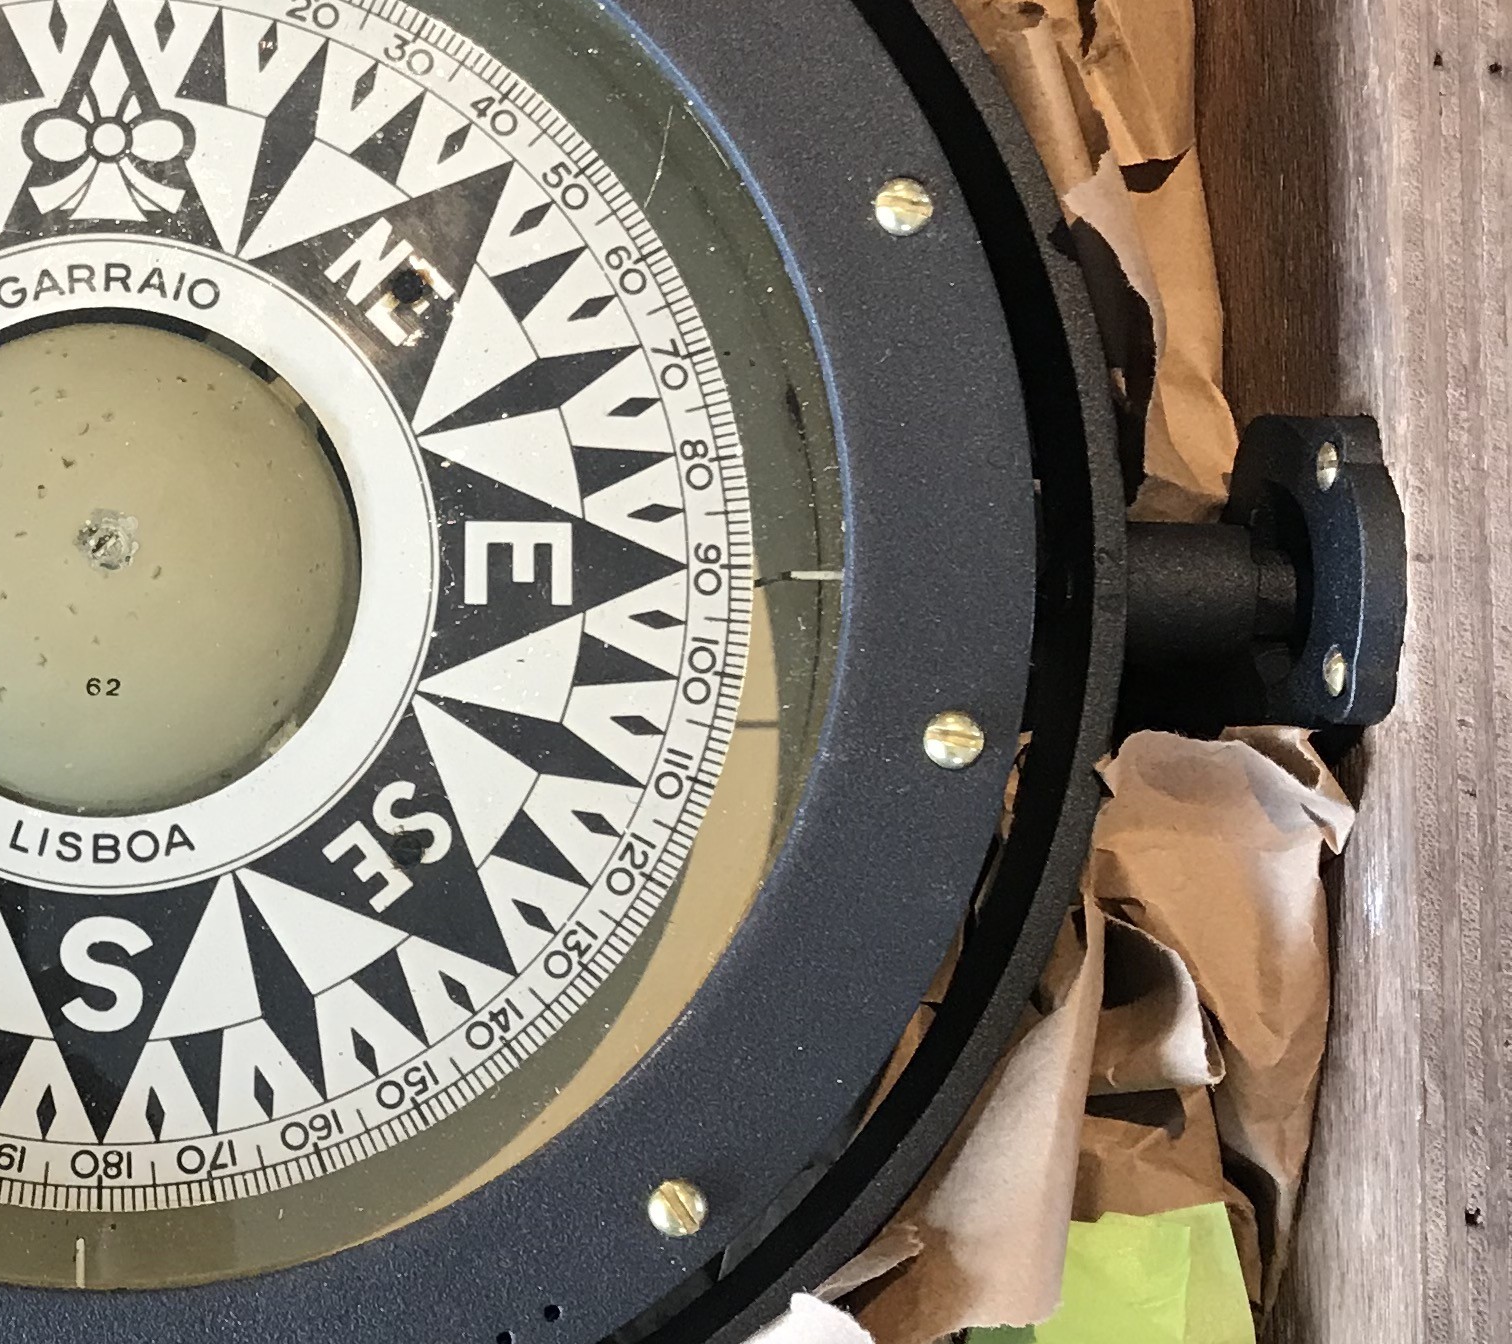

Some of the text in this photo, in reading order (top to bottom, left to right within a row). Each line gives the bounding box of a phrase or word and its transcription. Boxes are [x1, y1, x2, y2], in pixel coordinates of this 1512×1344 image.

[383, 33, 434, 76] 30
[470, 96, 518, 136] 40
[541, 161, 589, 210] 50
[324, 216, 455, 347] NE
[605, 244, 647, 296] 60
[650, 338, 689, 391] 70
[679, 439, 713, 491] 80
[464, 521, 573, 606] E
[693, 542, 722, 596] 90
[86, 677, 122, 697] 62
[682, 636, 719, 705] 100
[654, 748, 694, 800] 110
[9, 820, 196, 865] LISBOA
[322, 780, 453, 913] SE
[606, 832, 656, 897] 120
[60, 916, 154, 1033] S
[543, 920, 599, 980] 130
[465, 996, 524, 1051] 140
[376, 1059, 440, 1110] 150
[280, 1108, 344, 1152] 160
[70, 1149, 133, 1181] 180
[176, 1139, 238, 1176] 170
